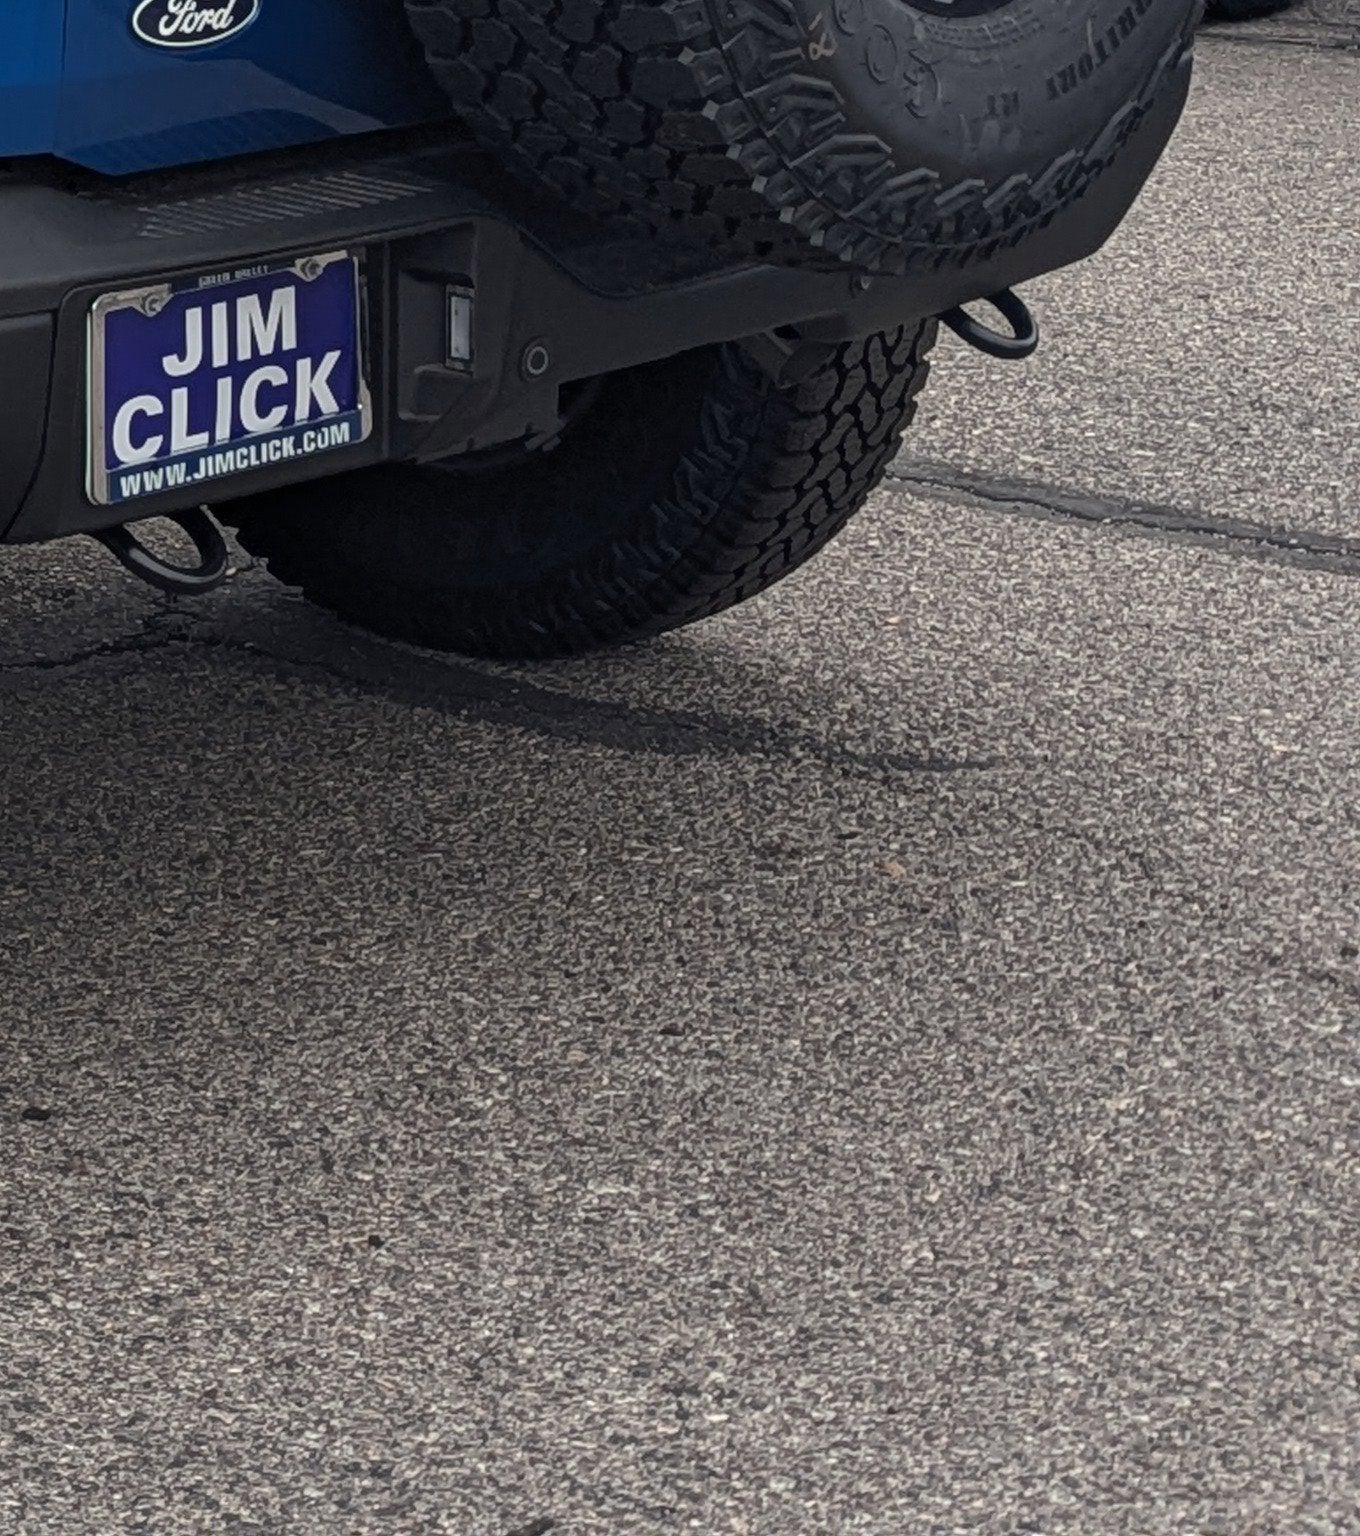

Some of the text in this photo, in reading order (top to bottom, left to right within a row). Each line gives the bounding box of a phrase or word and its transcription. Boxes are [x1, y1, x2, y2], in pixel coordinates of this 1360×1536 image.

[161, 284, 298, 378] JIM
[112, 349, 342, 465] CLICK
[119, 421, 351, 498] WWW.JIMCLICK.COM
